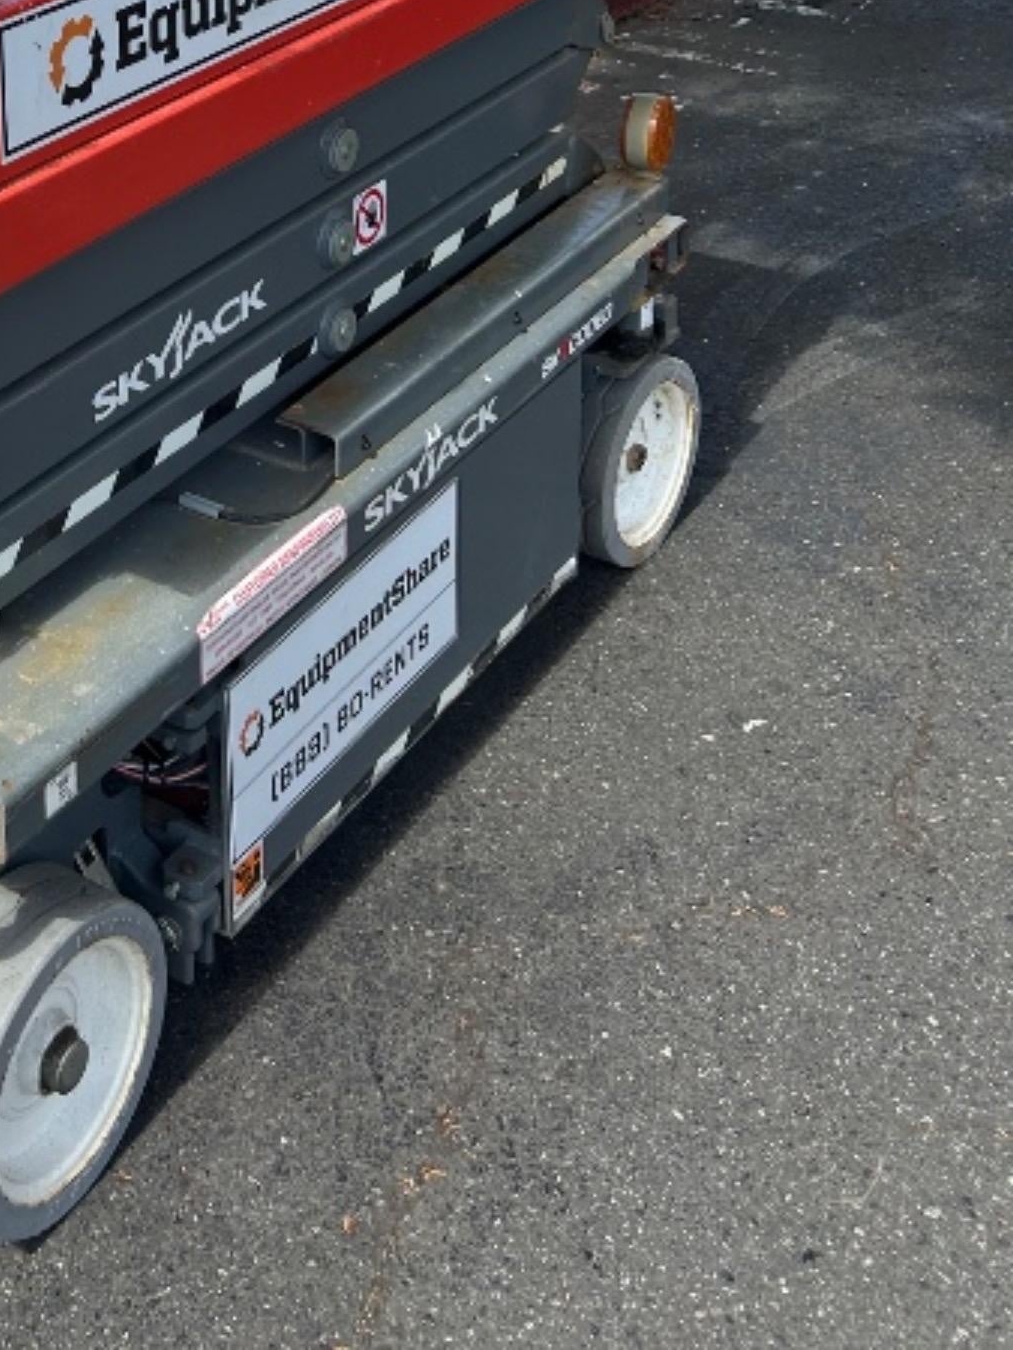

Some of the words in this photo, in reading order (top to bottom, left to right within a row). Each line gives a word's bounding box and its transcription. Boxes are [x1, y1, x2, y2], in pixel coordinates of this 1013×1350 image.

[92, 278, 267, 423] SKYJACK
[364, 395, 498, 532] SKYJACK
[269, 537, 450, 729] EquipmentShare
